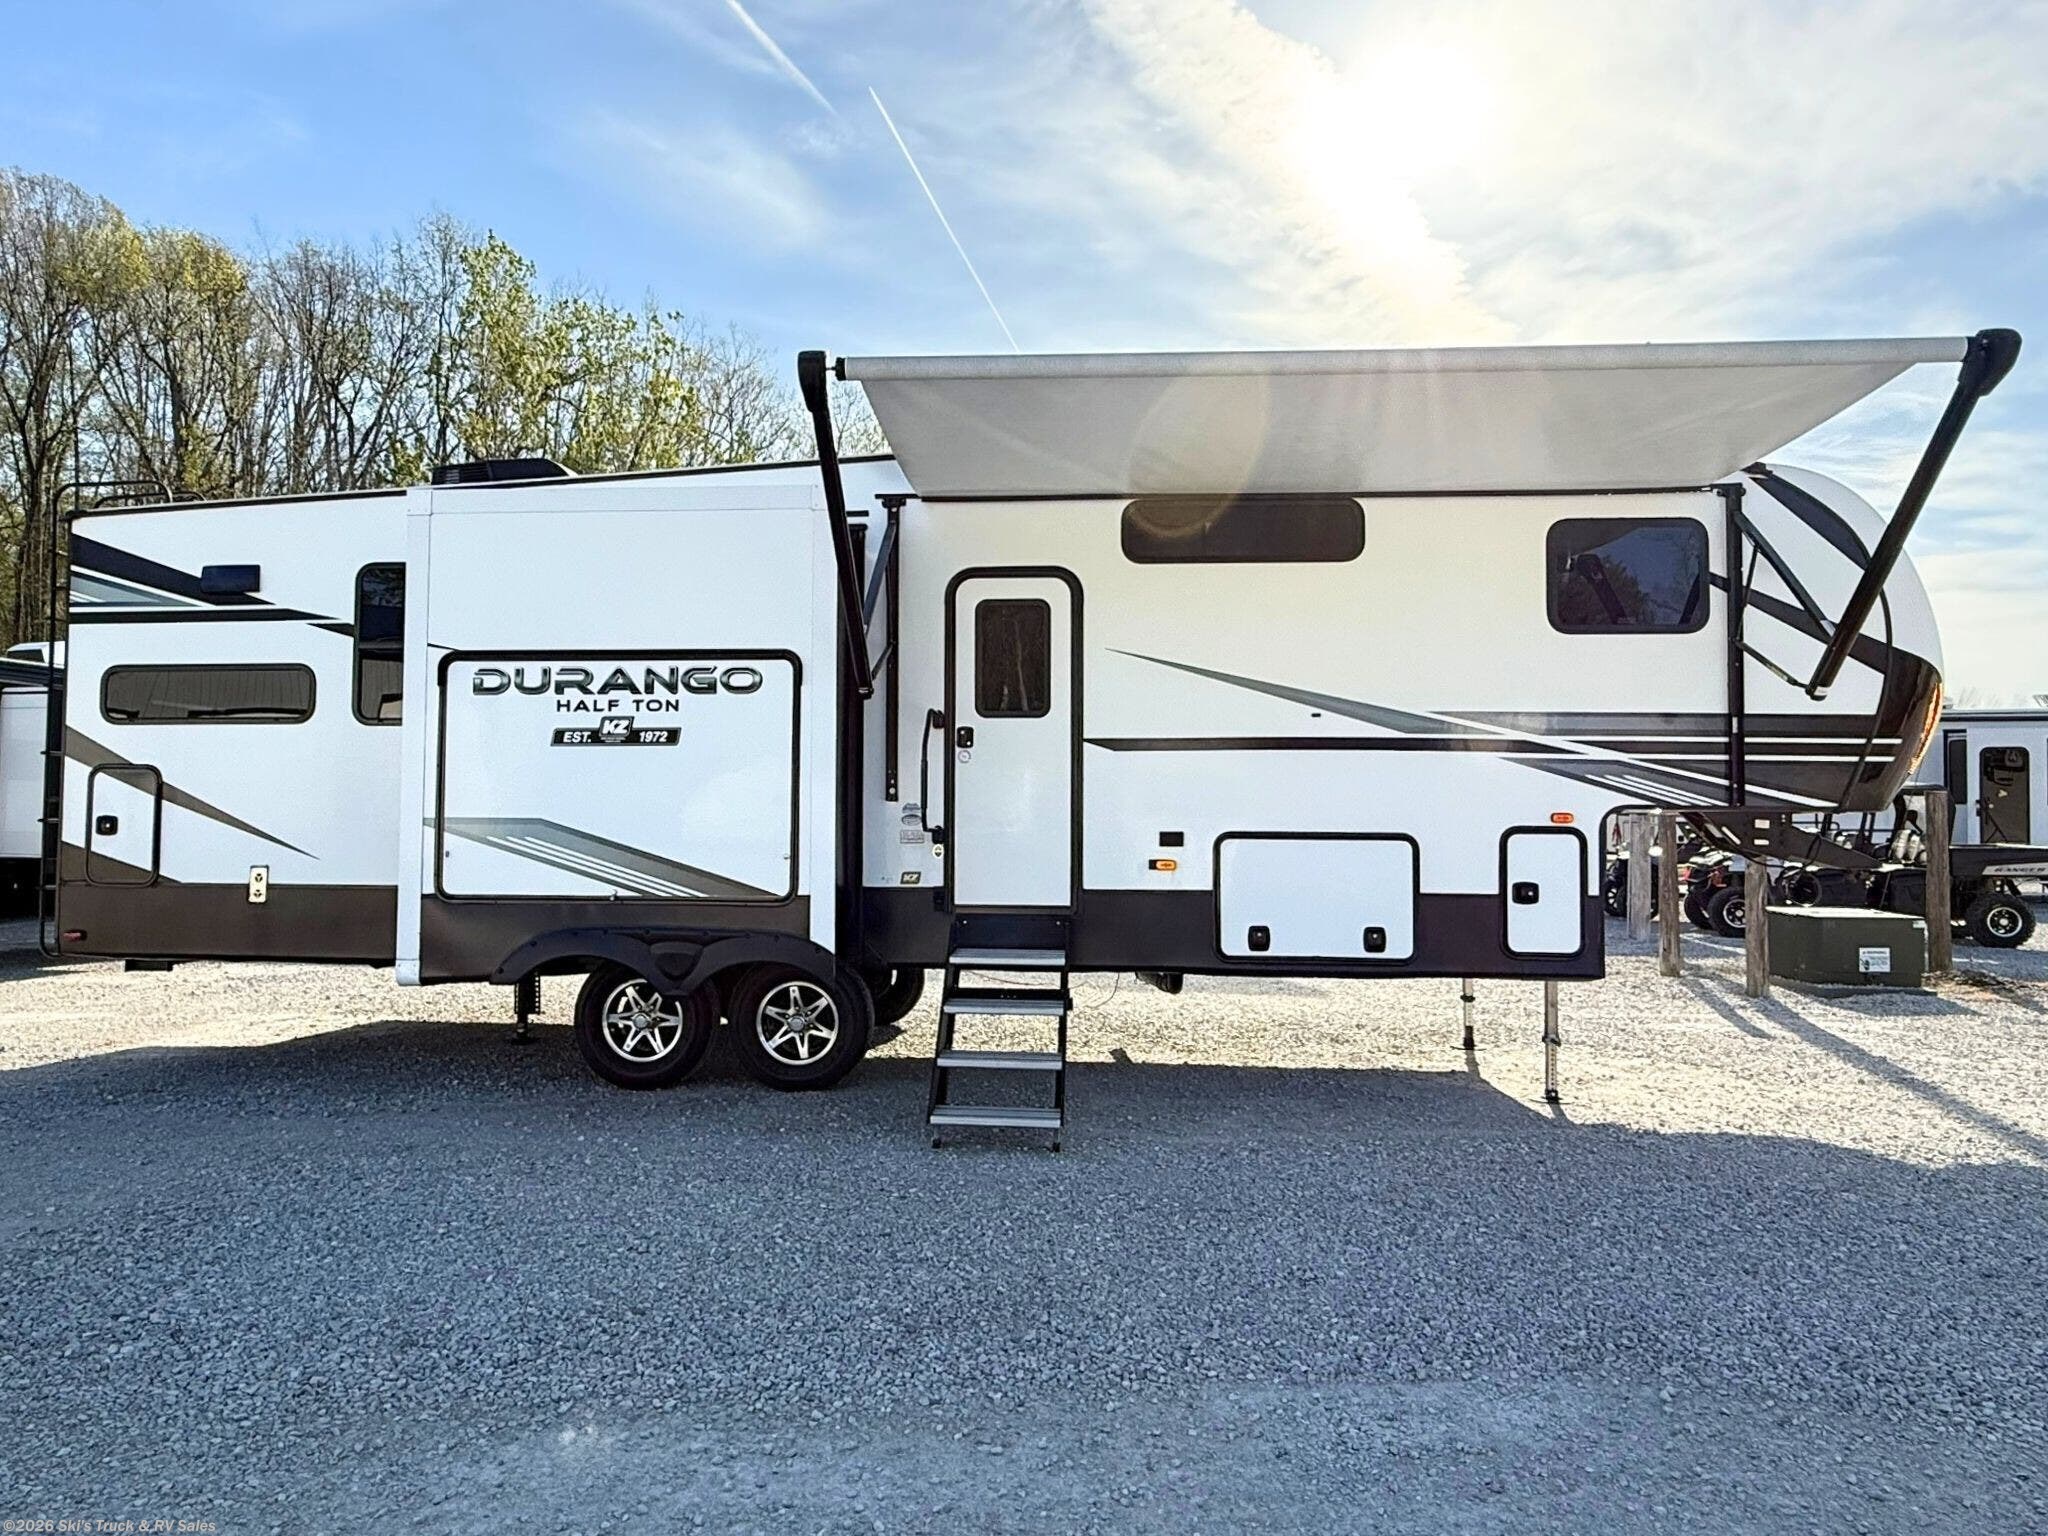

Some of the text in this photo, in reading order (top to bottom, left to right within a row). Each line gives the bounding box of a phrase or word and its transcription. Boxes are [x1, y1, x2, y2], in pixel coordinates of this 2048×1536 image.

[473, 666, 763, 695] DURANGO
[556, 699, 680, 712] HALF TON
[602, 720, 630, 735] KZ
[563, 731, 592, 743] EST.
[639, 731, 668, 743] 1972
